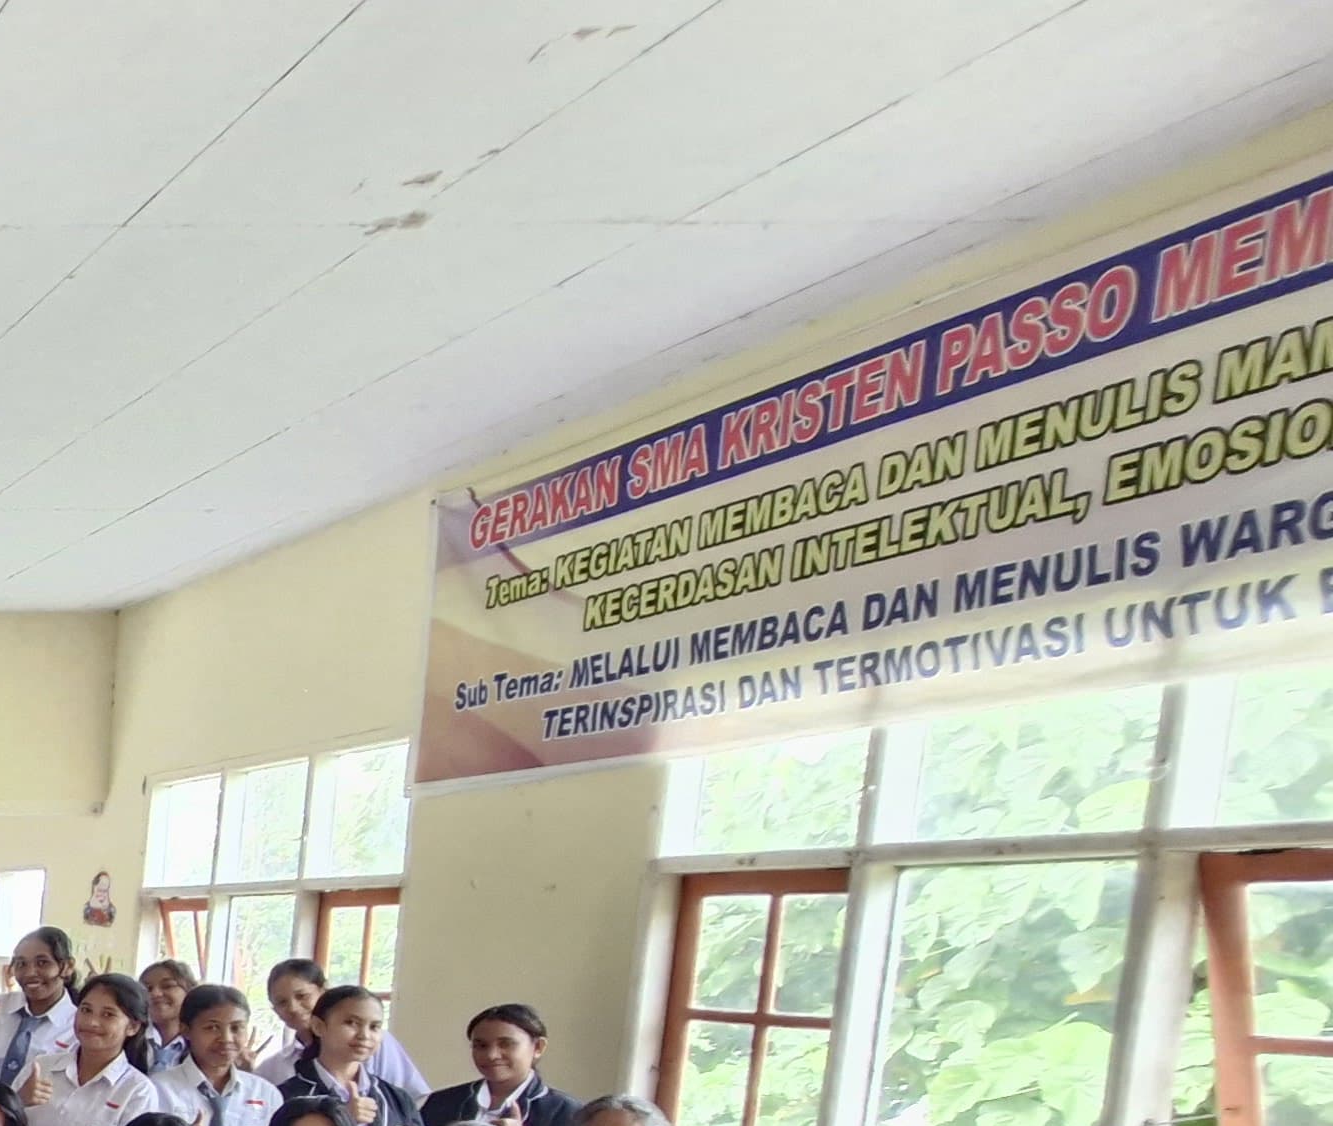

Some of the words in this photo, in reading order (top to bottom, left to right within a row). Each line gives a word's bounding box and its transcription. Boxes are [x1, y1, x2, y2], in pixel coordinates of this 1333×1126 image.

[469, 455, 621, 550] GERAKAN
[627, 430, 709, 502] SMA
[717, 339, 927, 471] KRISTEN
[935, 265, 1138, 398] PASSO
[1150, 184, 1333, 323] MEM
[486, 567, 549, 609] Tema:
[554, 515, 694, 590] KEGIATAN
[697, 461, 868, 550] MEMBACA
[877, 431, 968, 500] DAN
[975, 359, 1202, 472] MENULIS
[455, 679, 488, 711] Sub
[493, 669, 563, 703] Tema:
[569, 636, 681, 690] MELALUI
[689, 601, 849, 666] MEMBACA
[862, 579, 940, 632] DAN
[953, 530, 1161, 613] MENULIS
[1180, 490, 1333, 568] WARG
[583, 543, 784, 632] KECERDASAN
[791, 468, 1092, 583] INTELEKTUAL,
[1103, 397, 1333, 506] EMOSIO
[542, 680, 727, 740] TERINSPIRASI
[738, 666, 803, 710] DAN
[813, 612, 1086, 696] TERMOTIVASI
[1104, 573, 1299, 648] UNTUK
